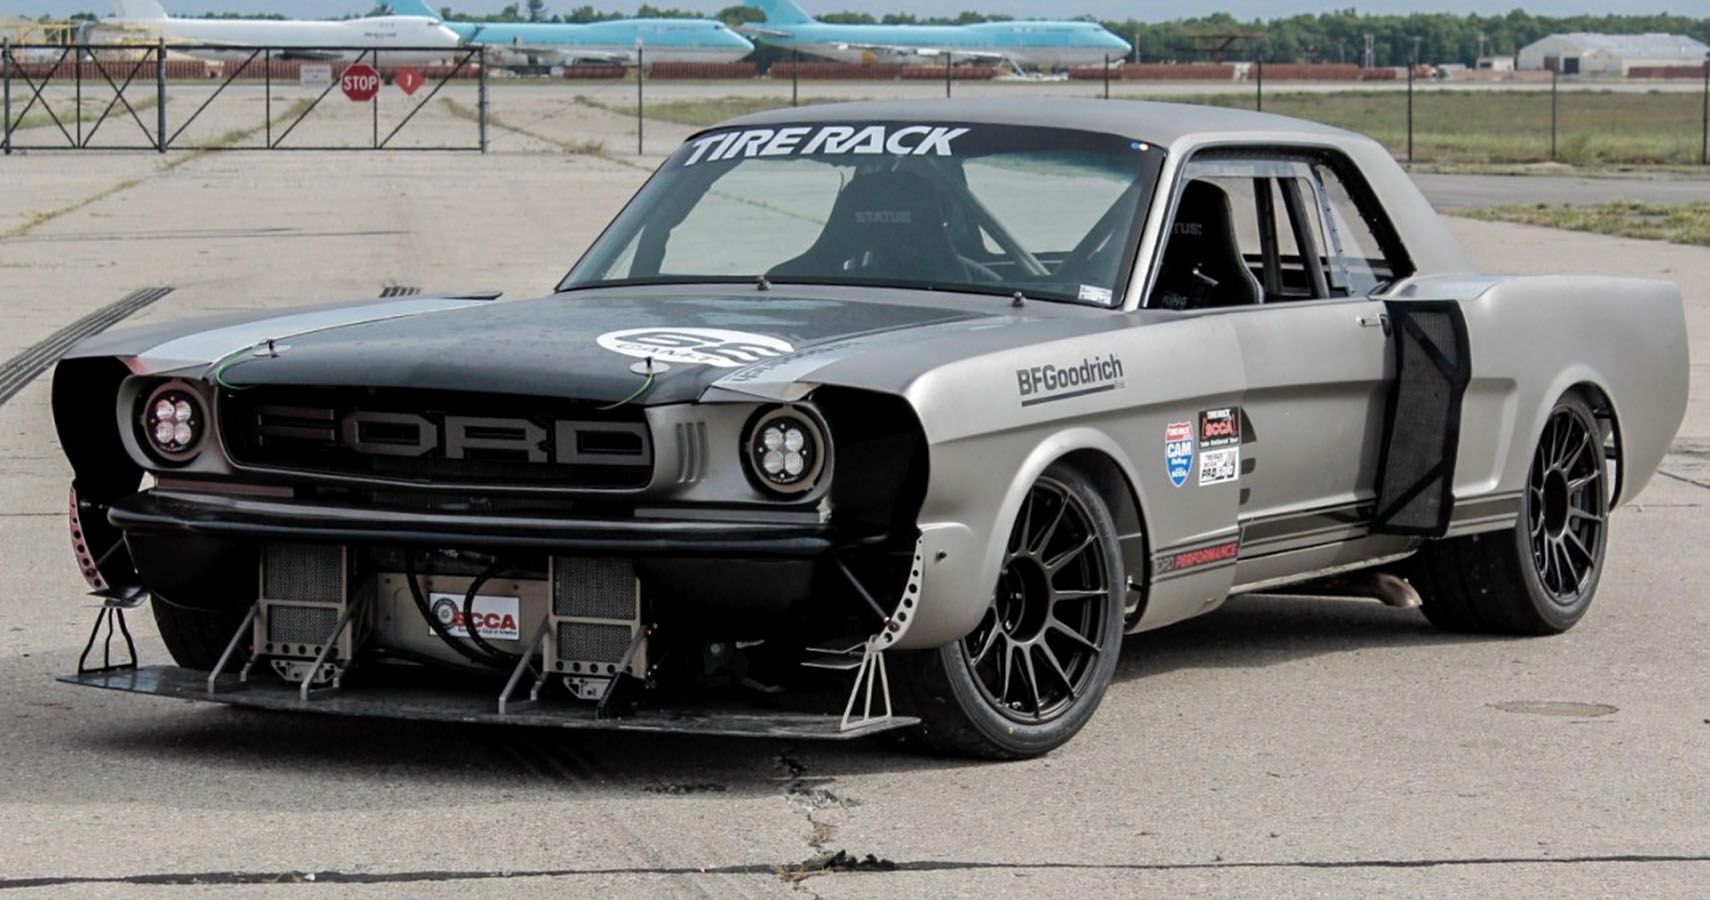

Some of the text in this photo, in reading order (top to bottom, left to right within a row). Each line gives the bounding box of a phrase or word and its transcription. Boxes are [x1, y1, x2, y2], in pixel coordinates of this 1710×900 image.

[343, 75, 377, 91] STOP
[684, 126, 972, 166] TIRE RACK
[1016, 353, 1123, 396] BFGoodrich
[257, 405, 651, 465] FORD
[1167, 441, 1192, 458] CAM
[1175, 542, 1238, 569] PERFORMANCE
[453, 612, 517, 630] SCCA
